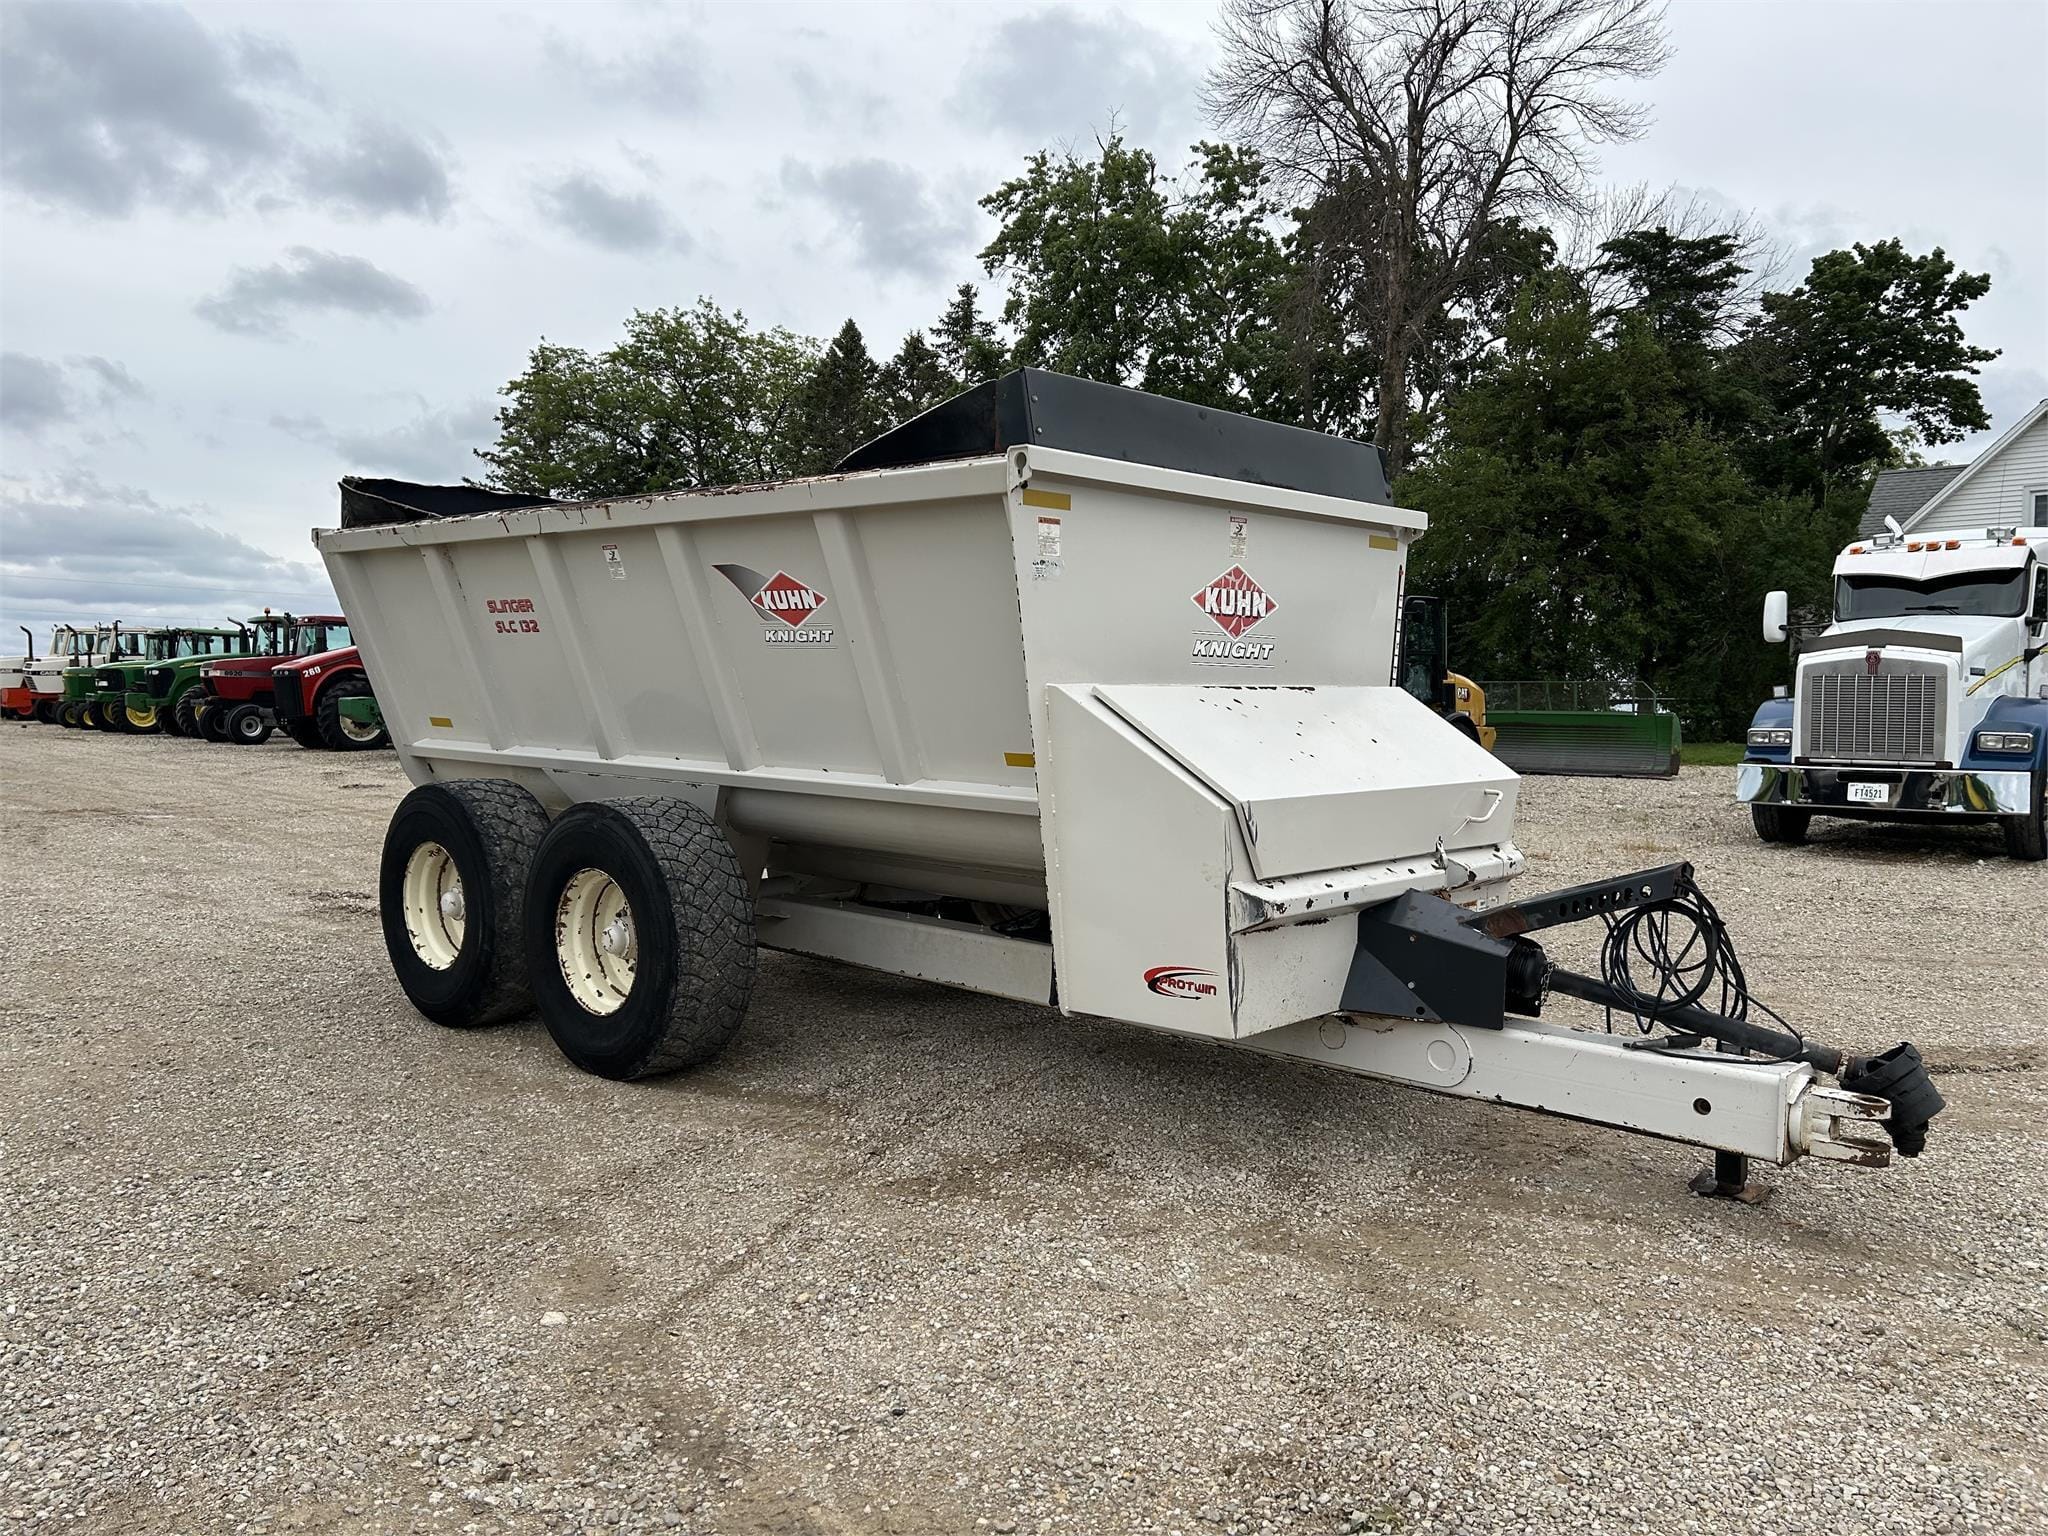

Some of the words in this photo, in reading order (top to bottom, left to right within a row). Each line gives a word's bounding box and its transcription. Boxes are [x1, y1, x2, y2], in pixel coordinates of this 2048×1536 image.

[486, 598, 535, 614] SLINGER
[760, 589, 817, 611] KUHN
[1204, 586, 1267, 618] KUHN
[495, 620, 518, 633] SLC
[519, 619, 540, 633] 132
[764, 629, 833, 643] KNIGHT
[1192, 639, 1274, 660] KNIGHT
[1457, 687, 1468, 699] CAT
[1854, 788, 1882, 799] FT4521
